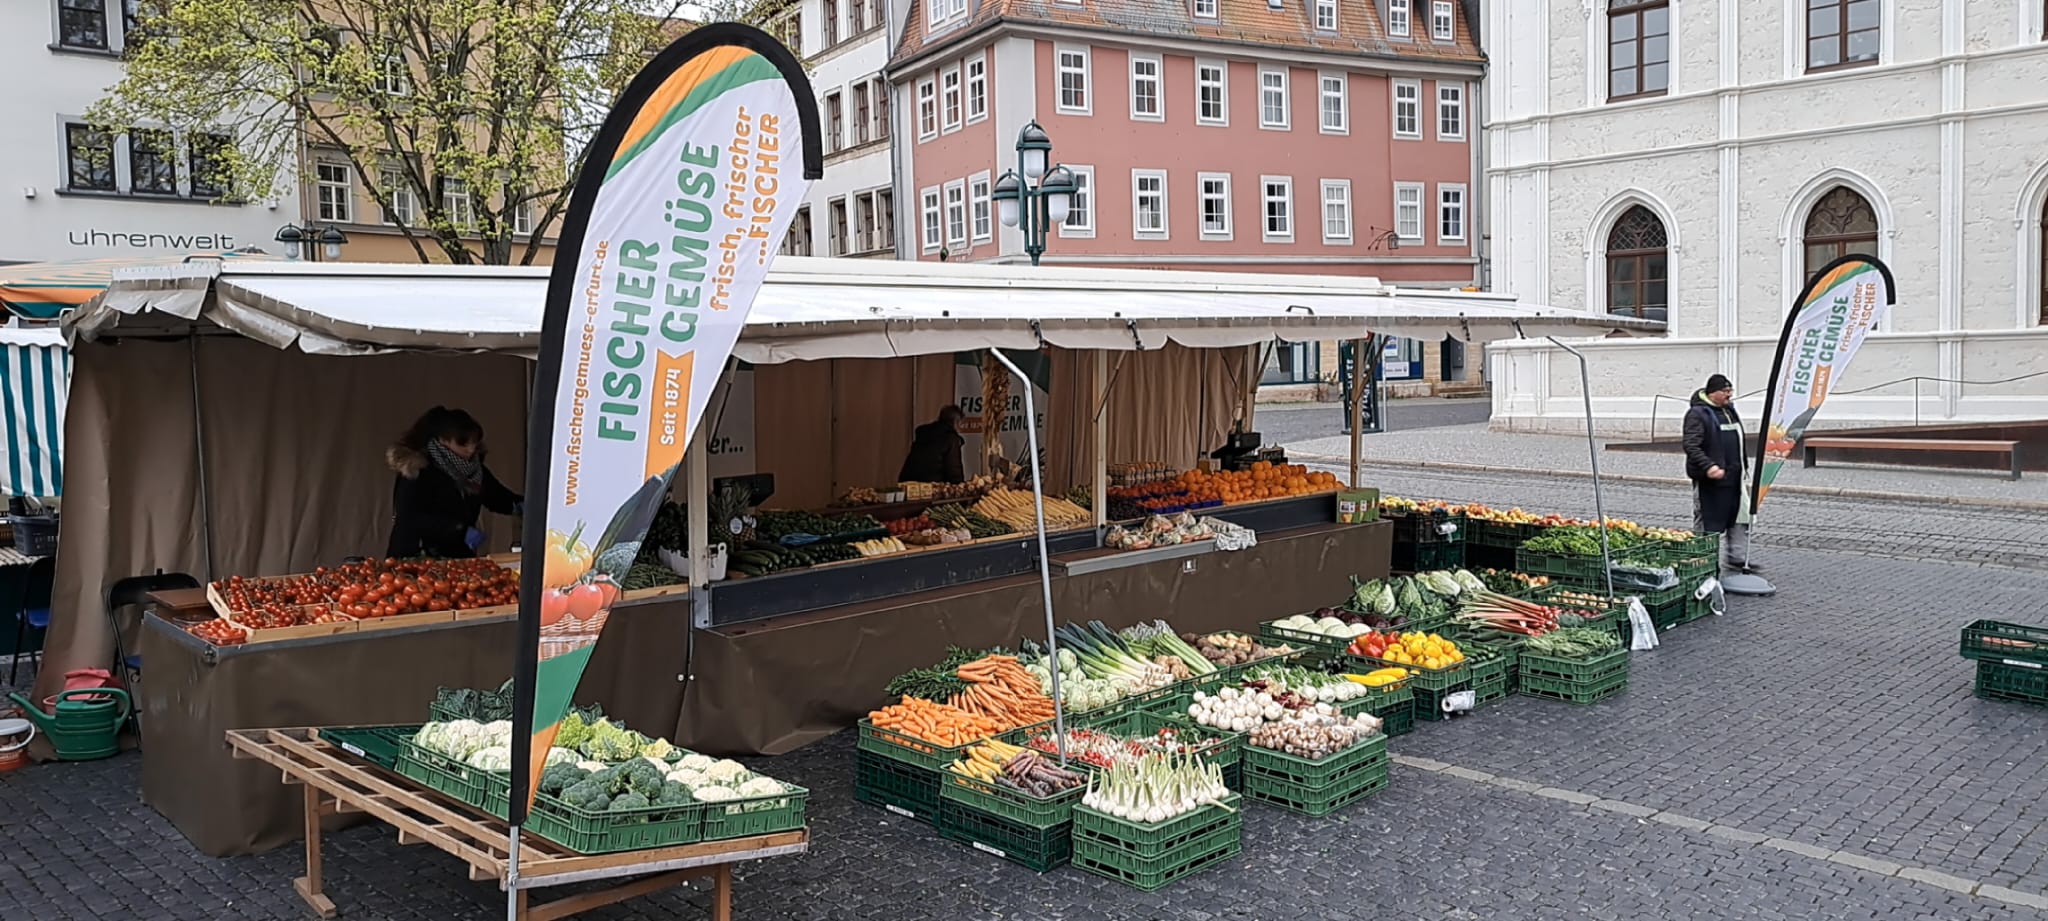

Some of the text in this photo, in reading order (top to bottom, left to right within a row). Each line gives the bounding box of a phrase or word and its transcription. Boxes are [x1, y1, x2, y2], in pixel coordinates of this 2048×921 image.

[69, 229, 234, 250] uhrenwelt
[660, 142, 719, 342] GEMÜSE
[710, 106, 752, 311] frisch, frischer
[749, 113, 780, 265] ...FISCHER
[565, 240, 609, 506] www.fischergemuese-erfurt.de
[597, 239, 660, 441] FISCHER
[1792, 328, 1821, 394] FISCHER
[1819, 296, 1848, 362] GEMÜSE
[660, 368, 681, 445] Seit 1874
[961, 395, 1020, 412] FISER
